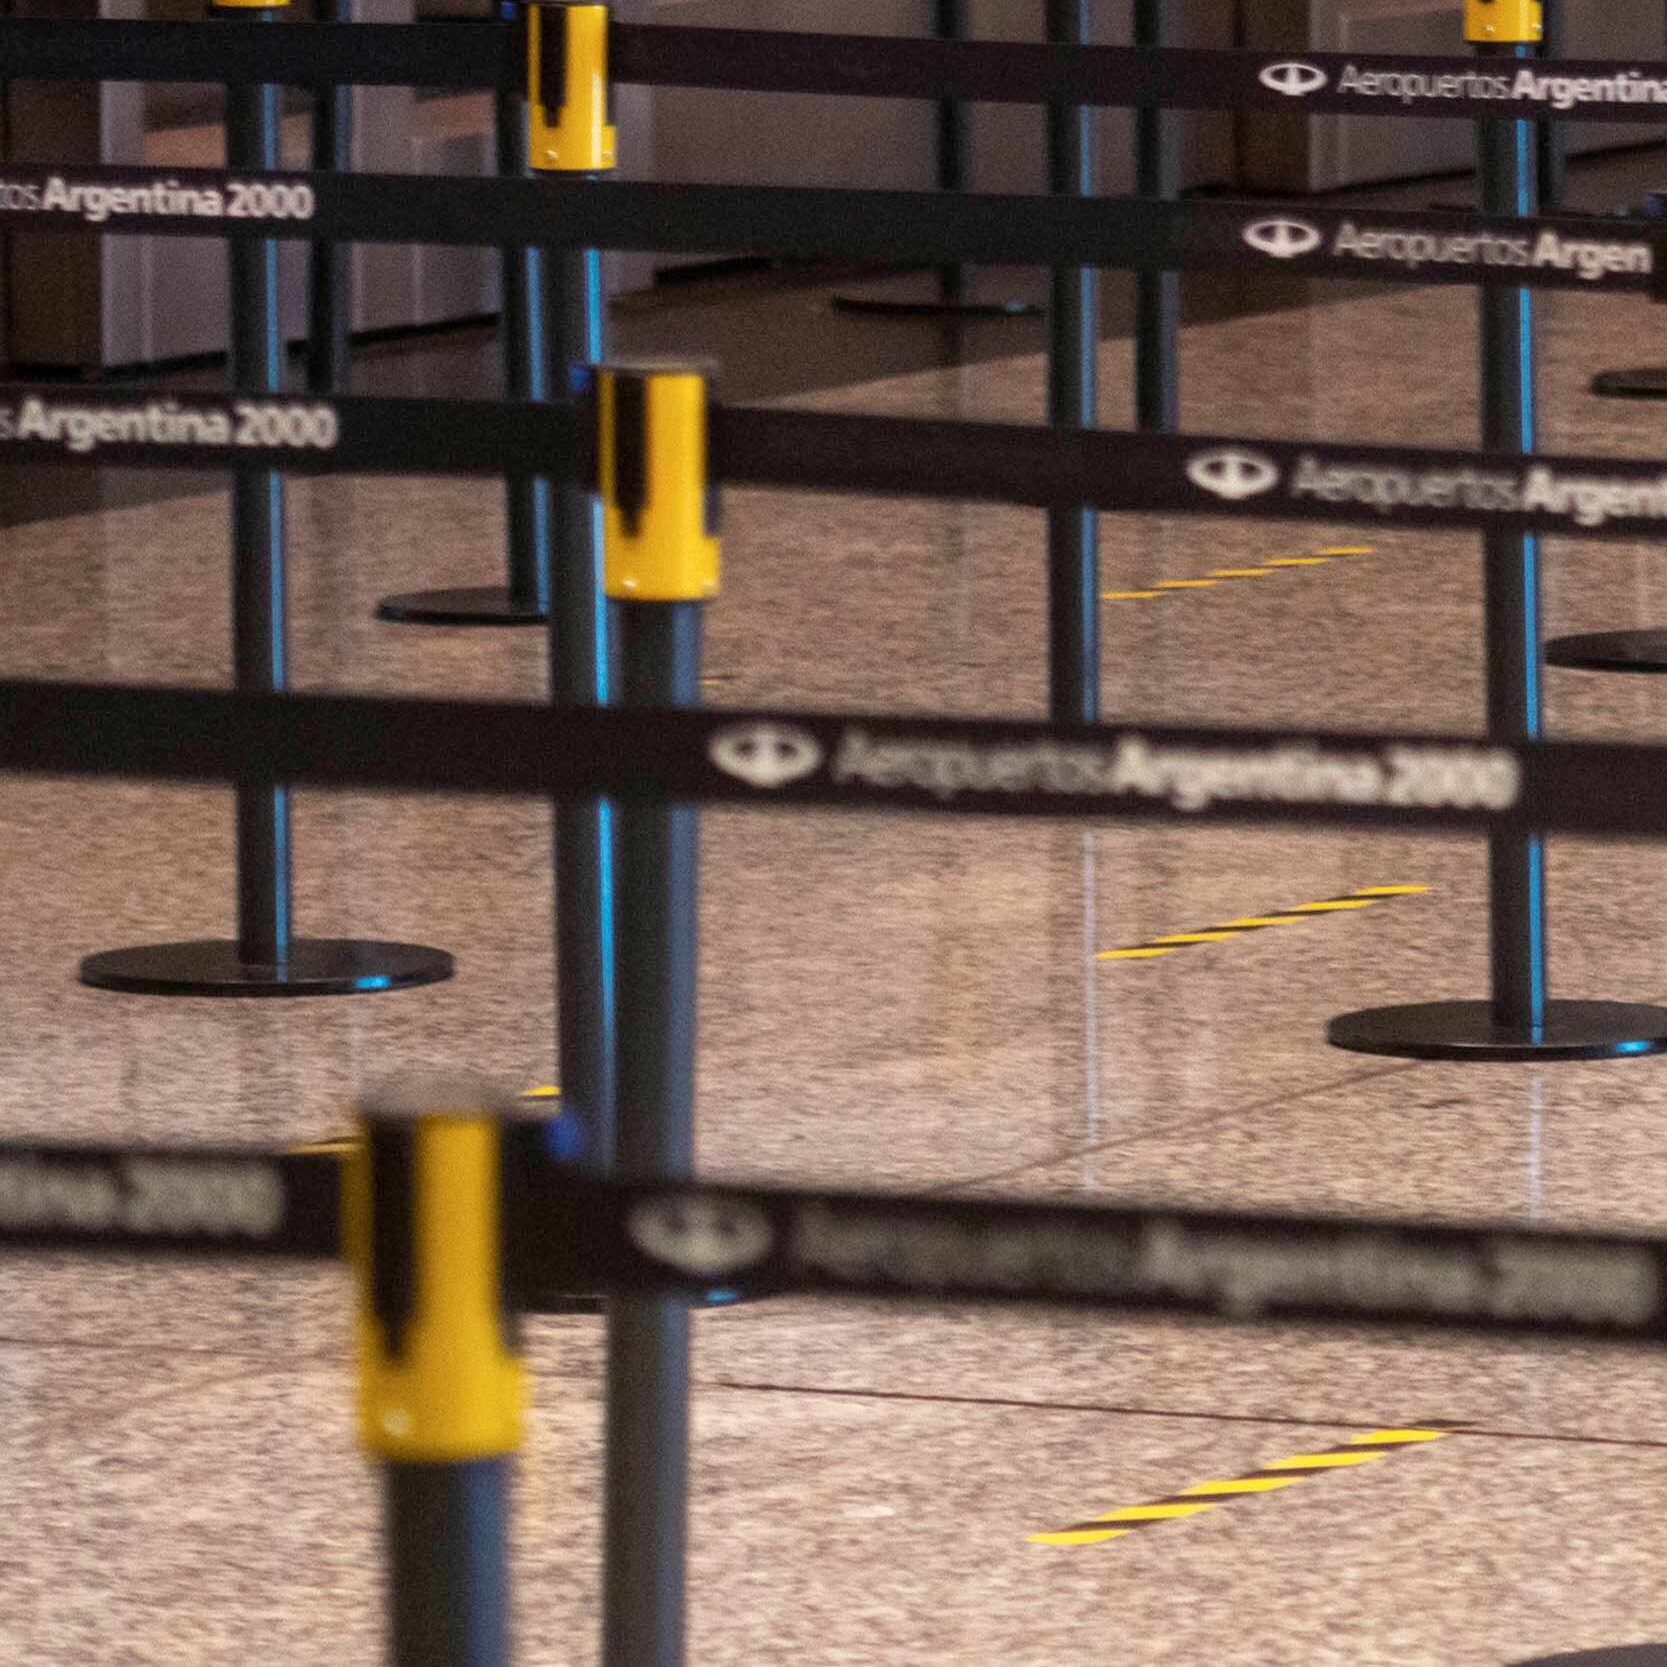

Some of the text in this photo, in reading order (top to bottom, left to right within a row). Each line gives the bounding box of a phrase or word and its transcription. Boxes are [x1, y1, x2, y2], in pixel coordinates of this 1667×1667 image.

[1336, 64, 1512, 104] Aeropuertos
[41, 175, 226, 222] Argentina
[225, 182, 317, 219] 2000
[1331, 220, 1654, 281] Aeropuertos Argen
[18, 398, 233, 453] Argentina
[232, 404, 341, 448] 2000
